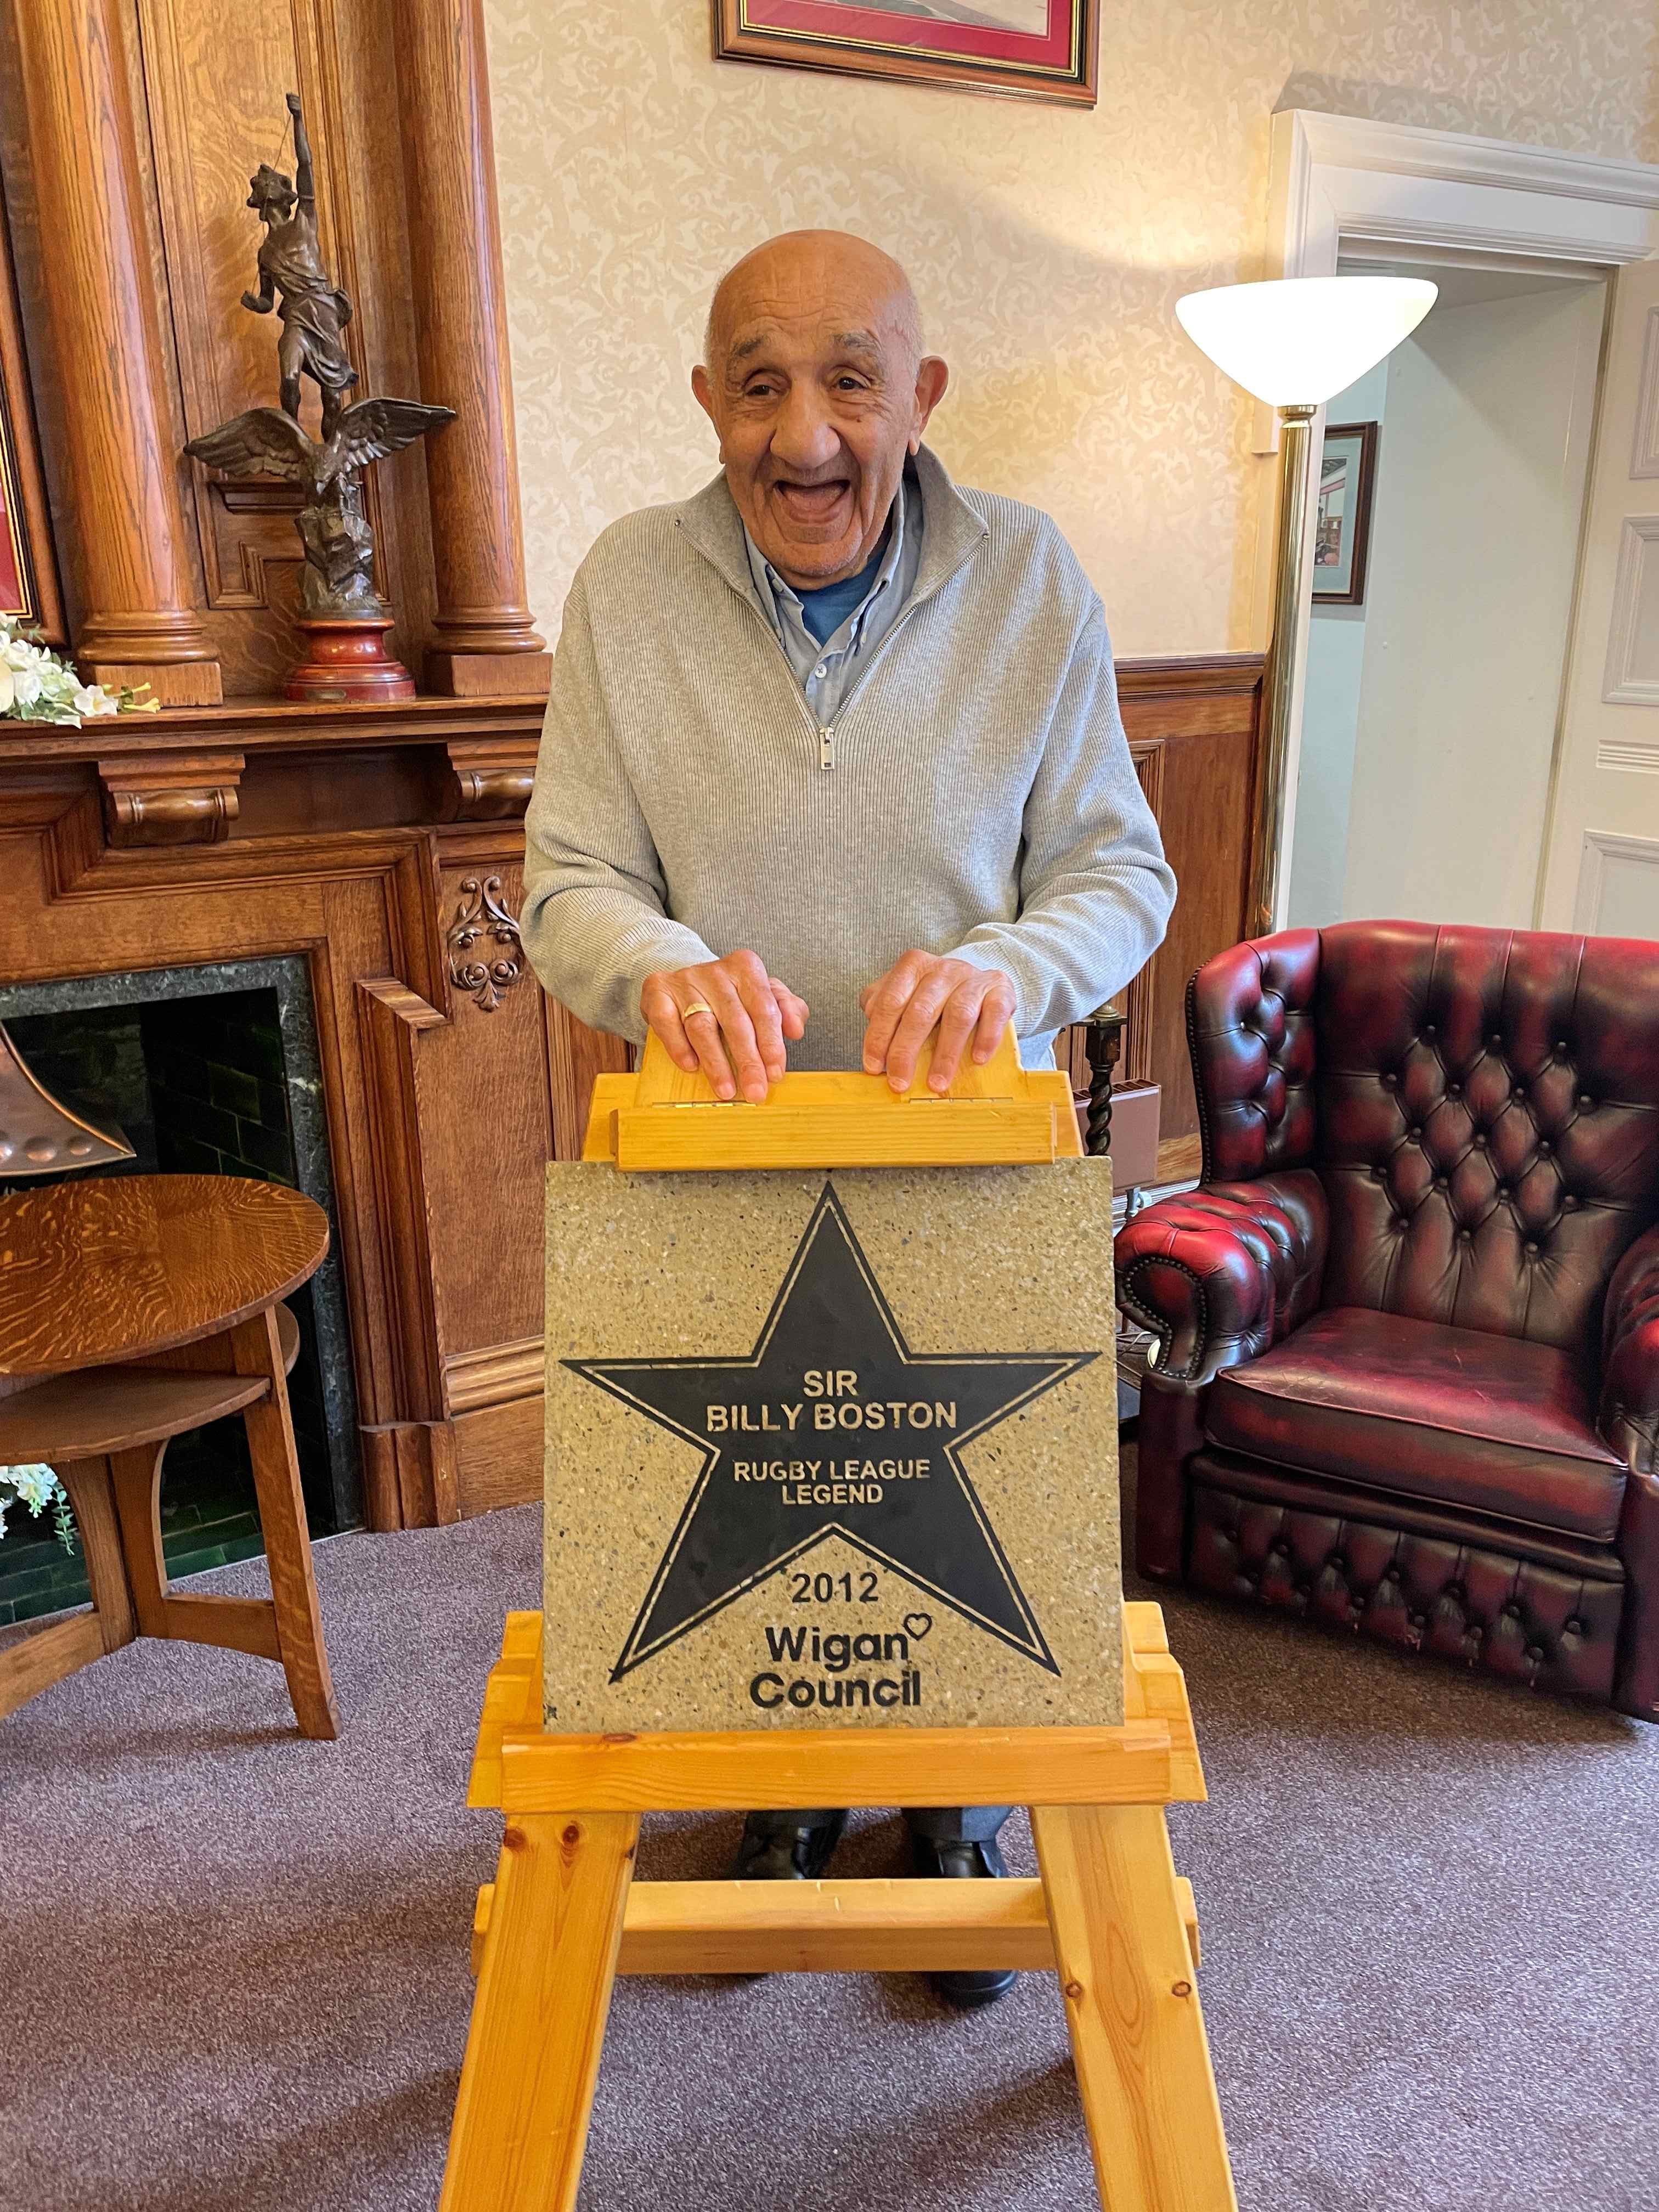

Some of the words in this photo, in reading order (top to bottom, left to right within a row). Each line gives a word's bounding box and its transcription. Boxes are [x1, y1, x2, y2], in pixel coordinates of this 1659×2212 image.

[803, 1369, 859, 1397] SIR
[707, 1403, 803, 1432] BILLY
[814, 1402, 957, 1431] BOSTON
[733, 1460, 822, 1482] RUGBY
[830, 1459, 930, 1481] LEAGUE
[782, 1484, 883, 1505] LEGEND
[792, 1572, 878, 1603] 2012
[765, 1627, 909, 1673] Wigan
[749, 1671, 921, 1708] Council
